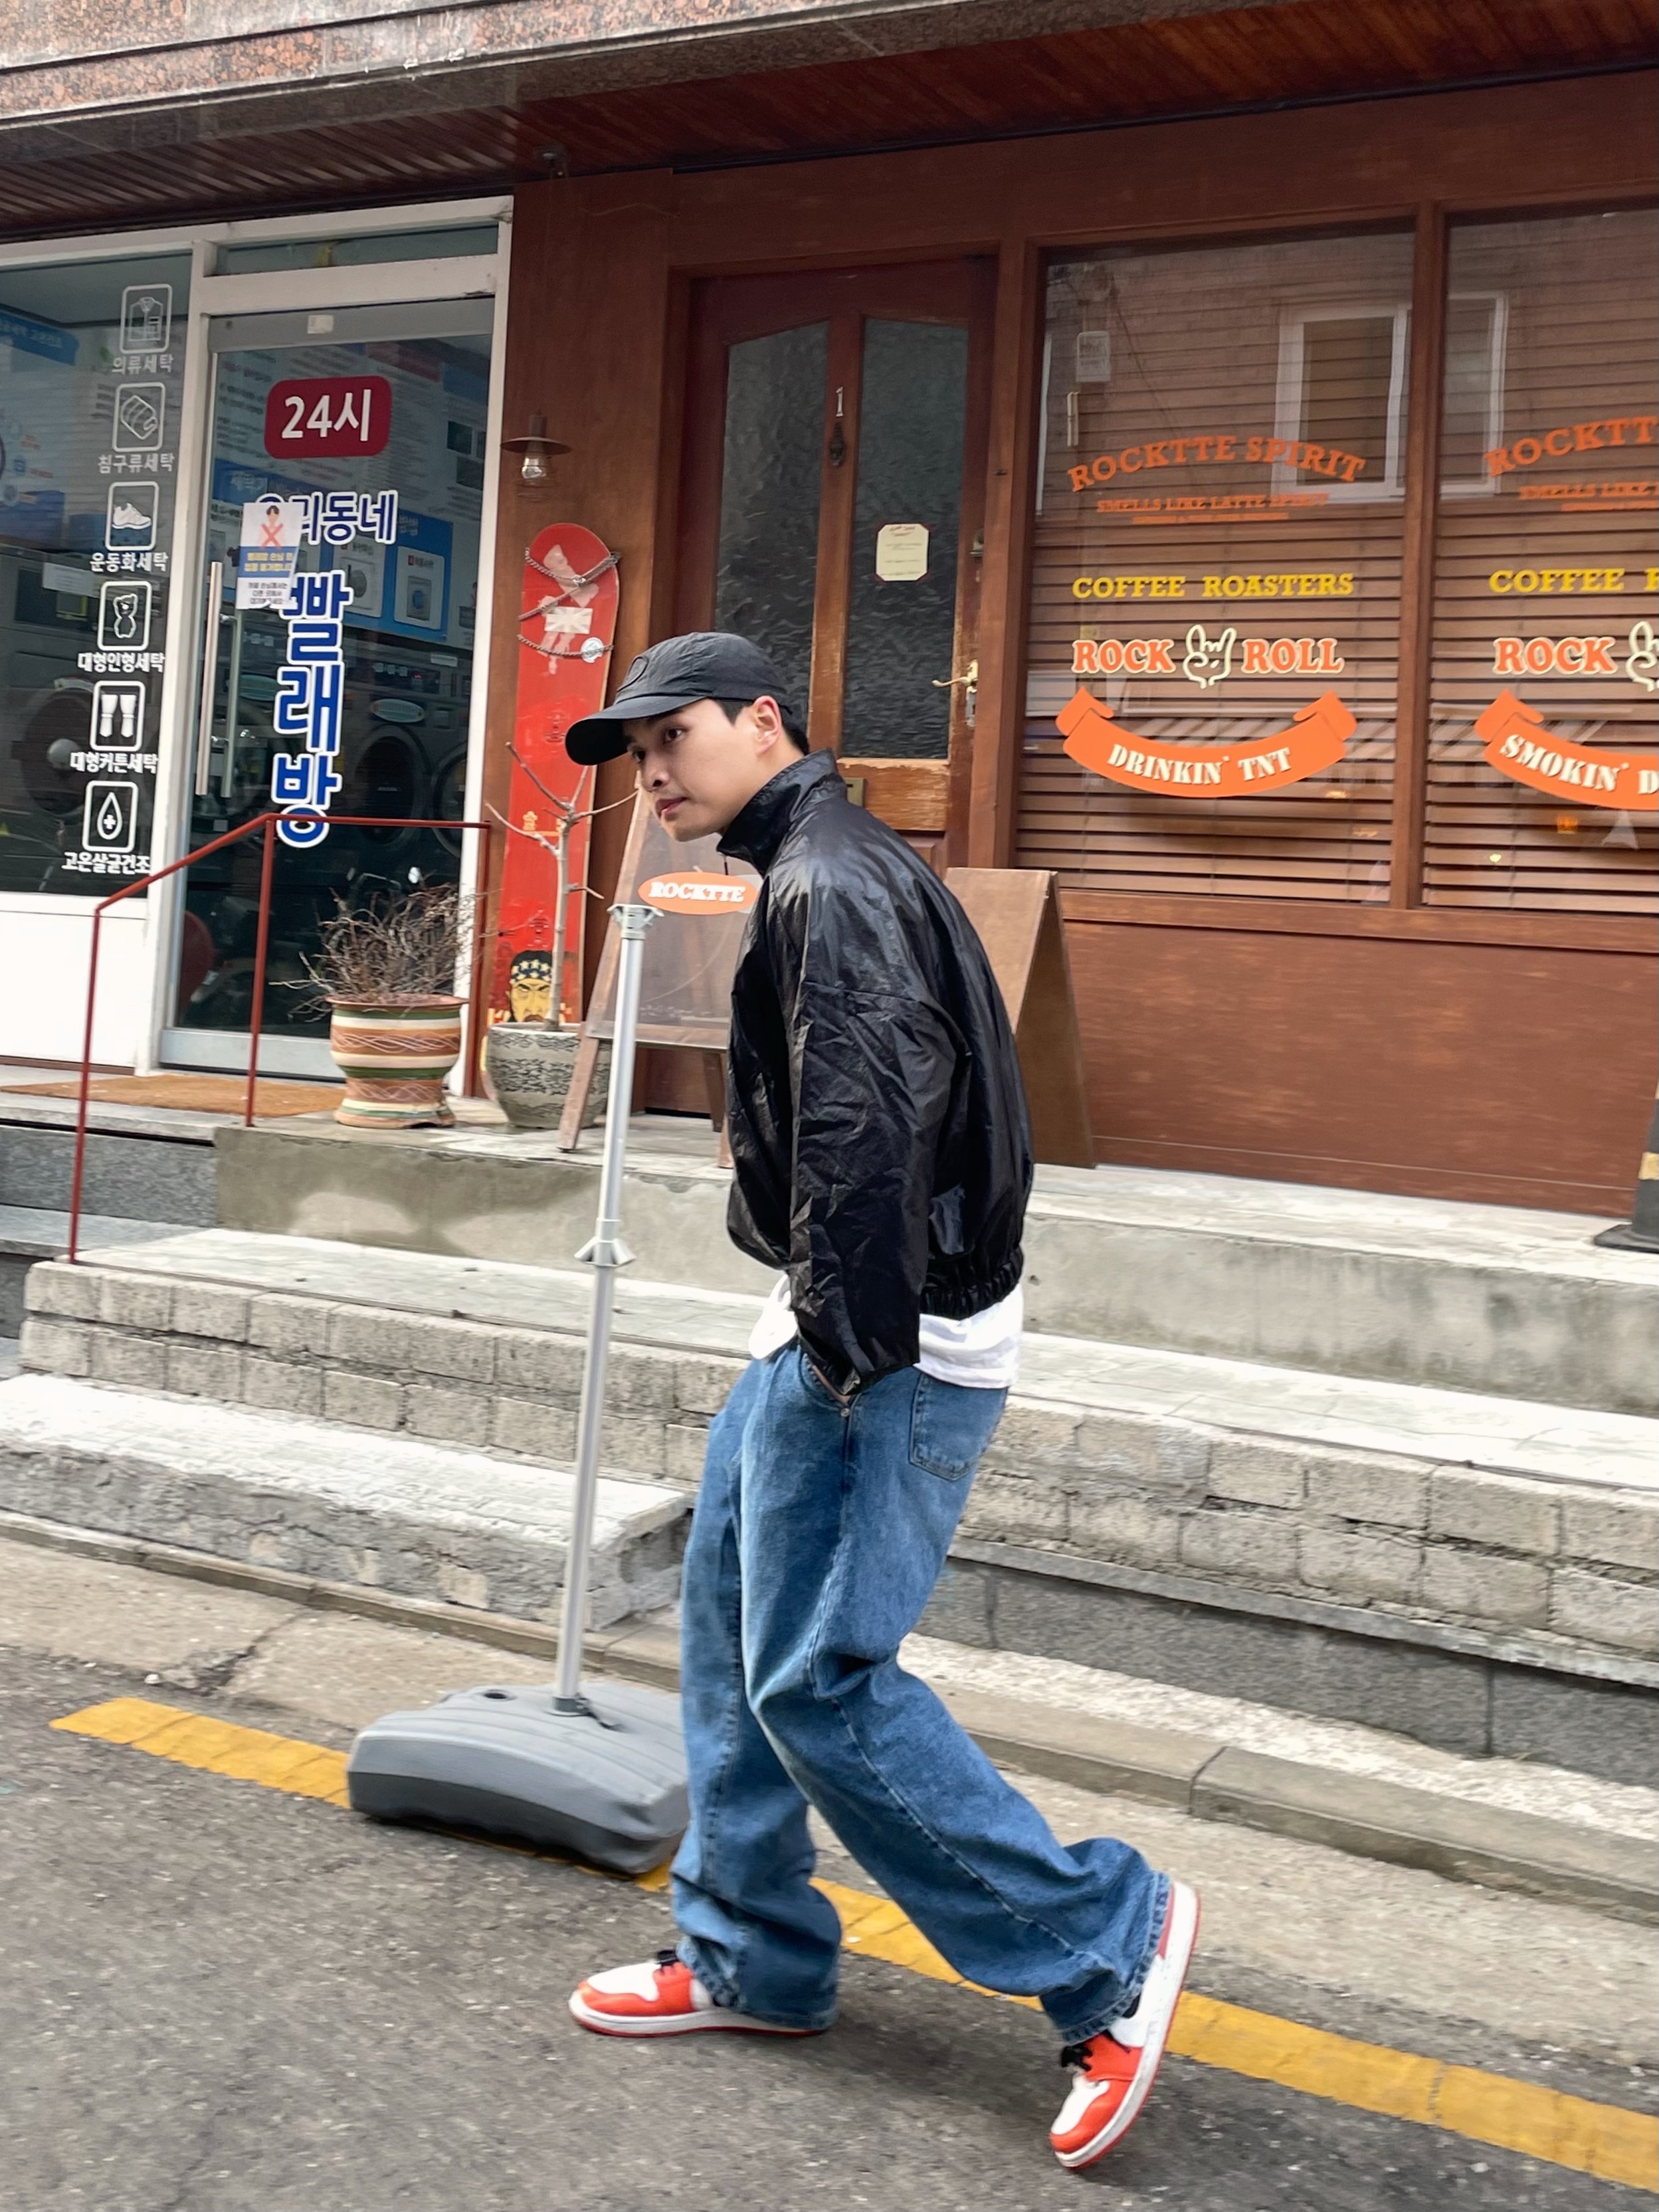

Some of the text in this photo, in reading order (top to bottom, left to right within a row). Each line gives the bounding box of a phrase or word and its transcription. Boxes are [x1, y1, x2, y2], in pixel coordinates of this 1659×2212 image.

[112, 353, 174, 375] 의류세탁
[282, 389, 371, 442] 24시
[98, 453, 175, 474] 침구류세탁
[1068, 435, 1367, 492] ROCKTTE SPIRIT
[256, 490, 398, 546] 리동네
[90, 552, 169, 572] 운동화세탁
[1072, 573, 1354, 599] COFFEE ROASTERS
[1489, 567, 1625, 593] COFFEE
[78, 652, 165, 673] 대형인형세탁
[1072, 638, 1345, 674] ROCK ROLL
[1492, 637, 1618, 675] ROCK
[273, 569, 354, 849] 빨래방
[70, 751, 159, 774] 대형커튼세탁
[1238, 748, 1292, 781] TNT
[61, 851, 150, 874] 고온살균건조
[648, 881, 746, 902] ROCKTTE
